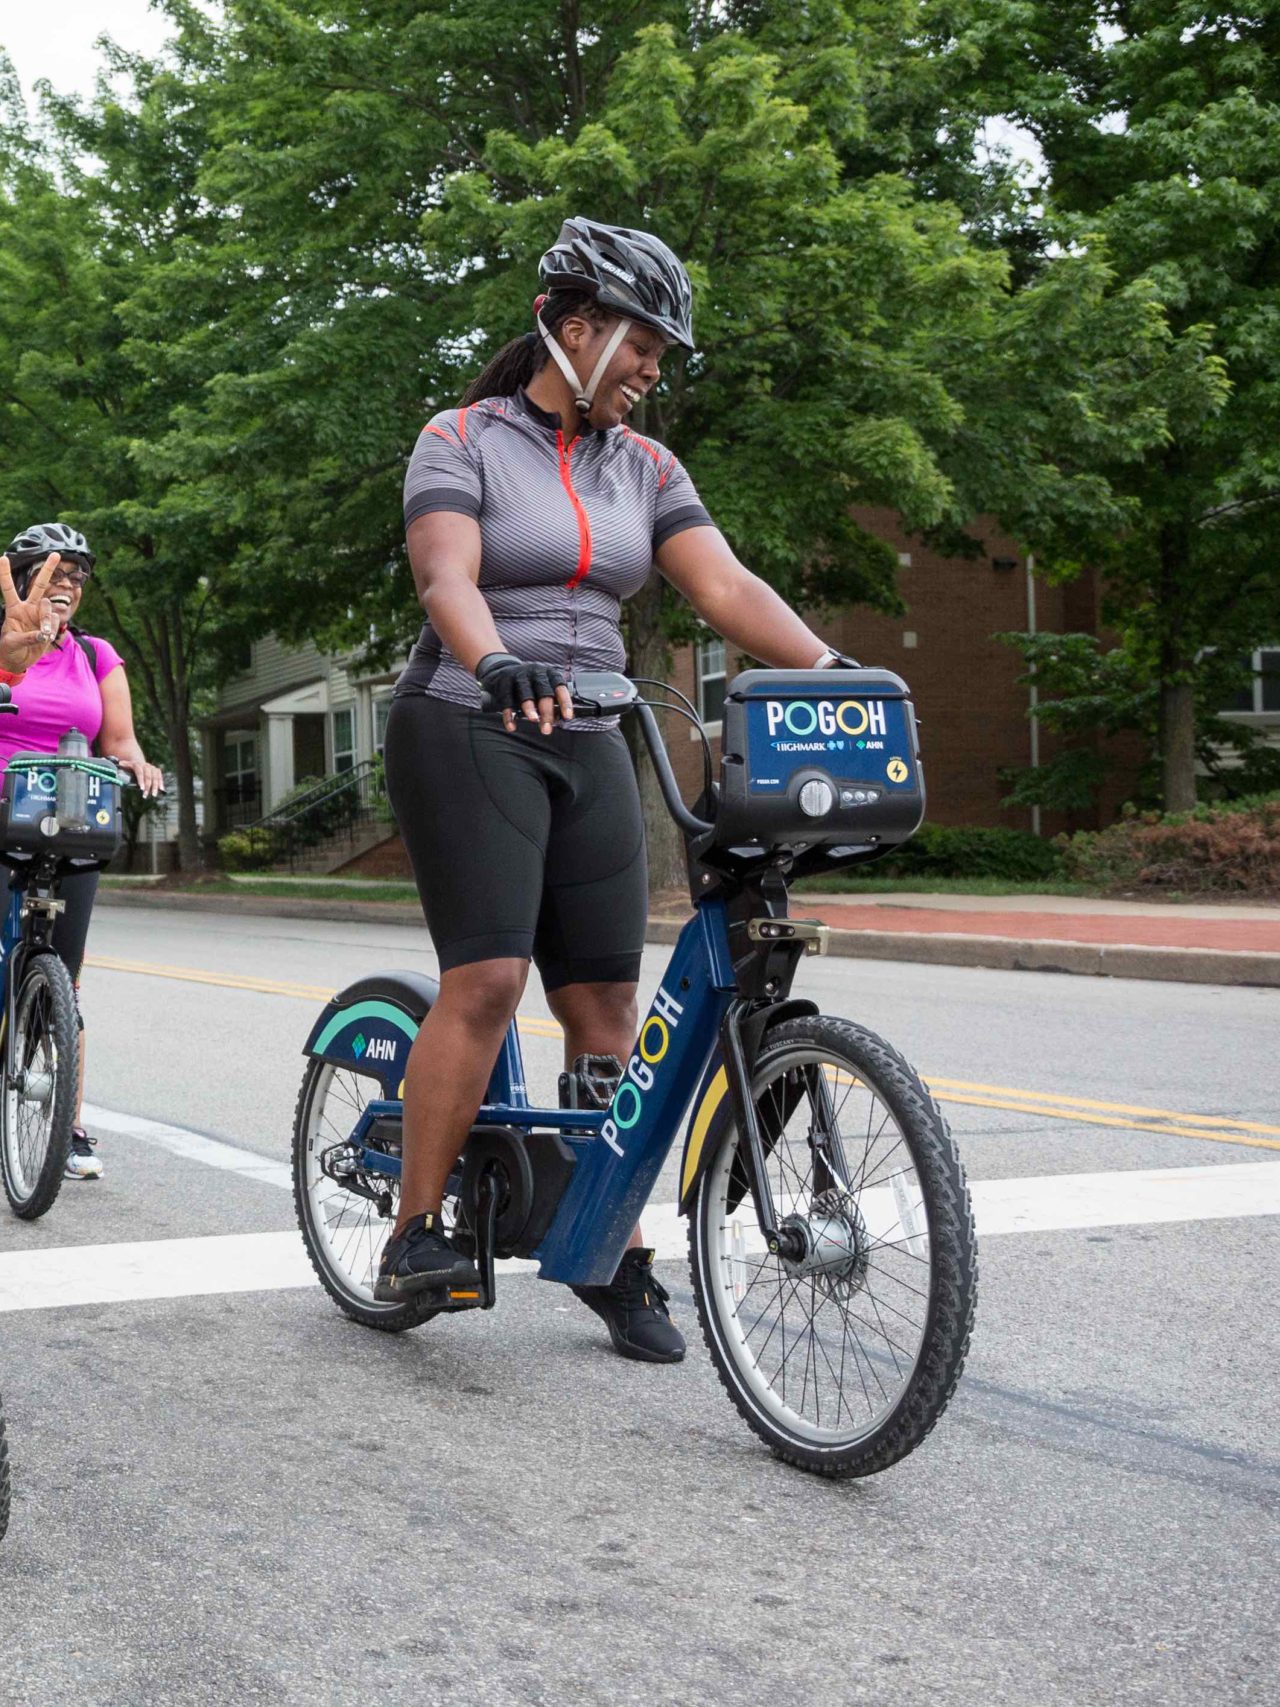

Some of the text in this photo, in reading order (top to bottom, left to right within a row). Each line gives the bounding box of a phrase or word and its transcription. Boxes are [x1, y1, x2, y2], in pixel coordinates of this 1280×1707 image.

[766, 700, 887, 736] POGOH
[775, 740, 884, 752] HIGHMARK AHN
[27, 769, 100, 797] POH
[365, 1037, 397, 1062] AHN
[600, 985, 684, 1158] POGOH
